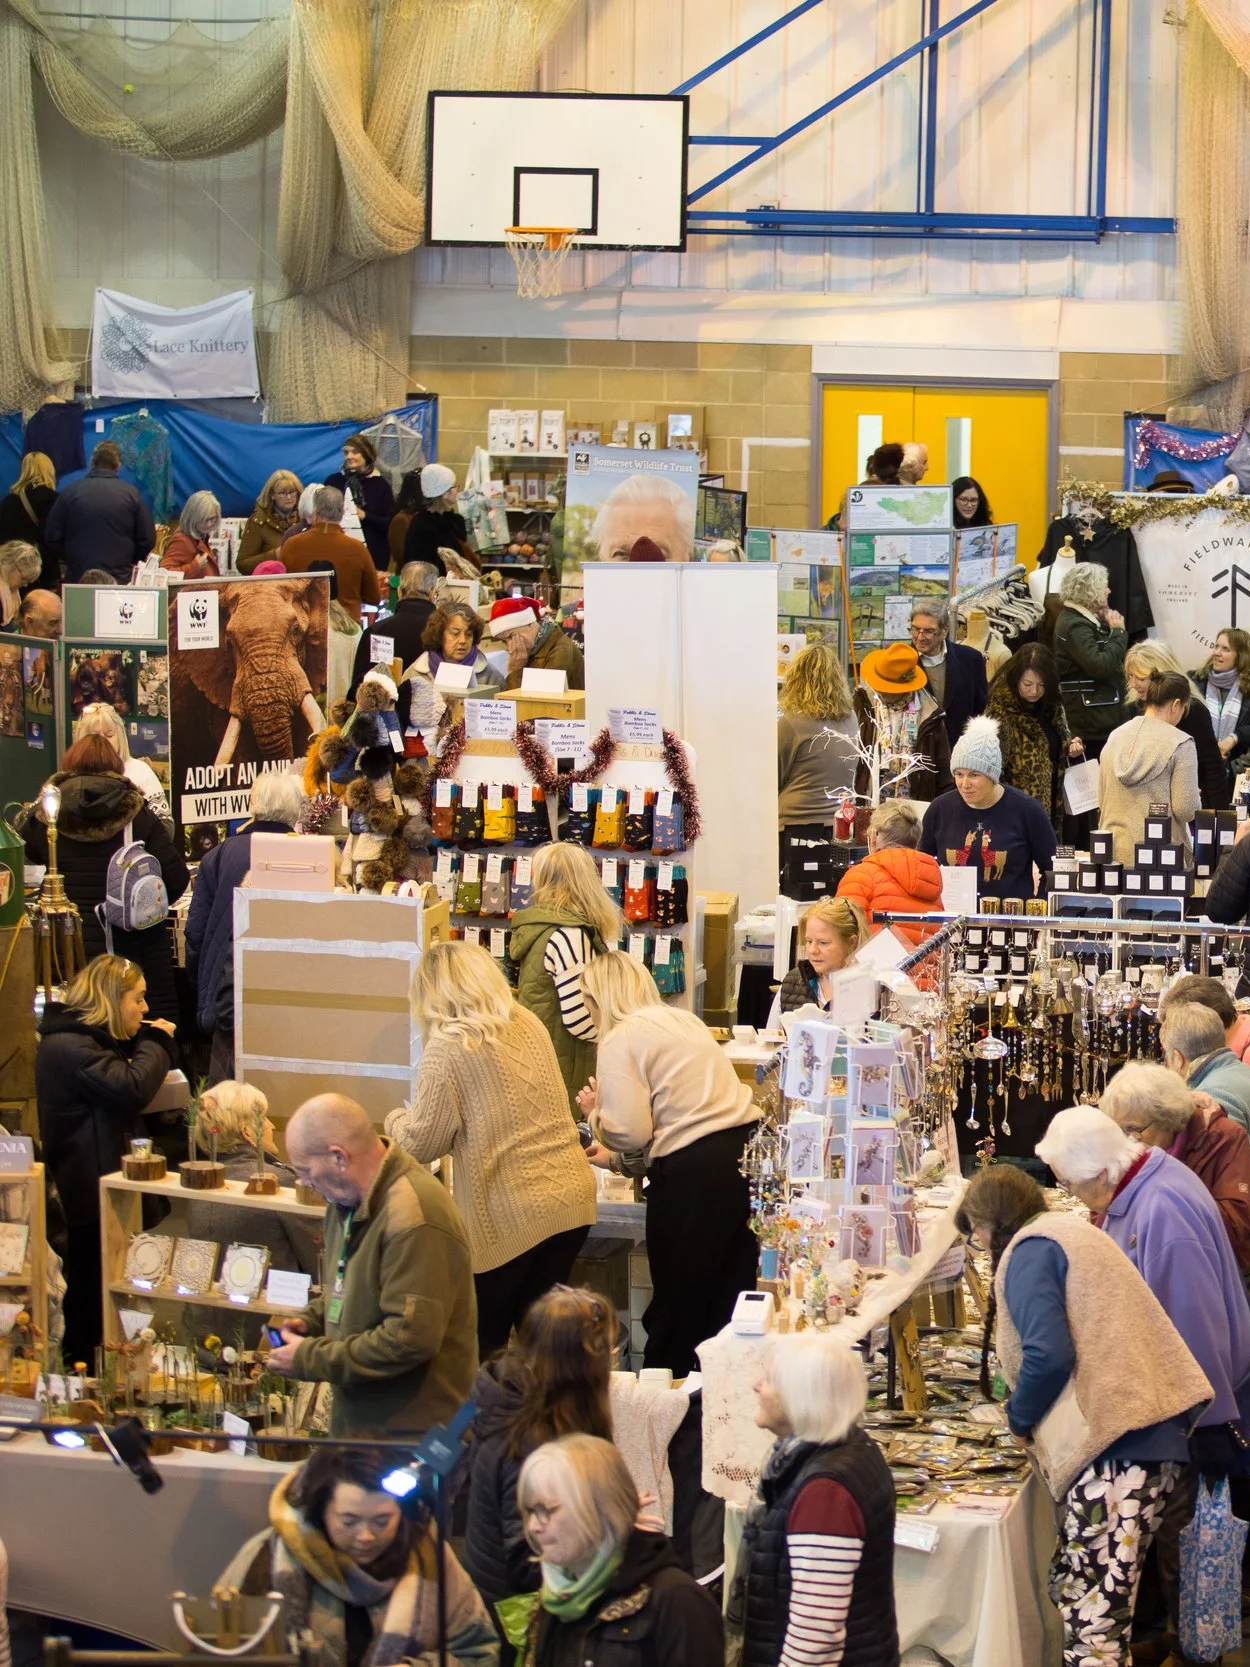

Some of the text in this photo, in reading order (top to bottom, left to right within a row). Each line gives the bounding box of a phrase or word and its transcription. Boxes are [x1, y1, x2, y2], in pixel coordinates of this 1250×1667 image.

[153, 339, 249, 355] Lace Knittery
[593, 457, 633, 469] Somerset
[634, 459, 668, 471] Wildlife
[670, 463, 694, 473] Trust
[184, 764, 234, 790] ADOPT
[237, 761, 257, 785] AN
[195, 797, 227, 817] WITH
